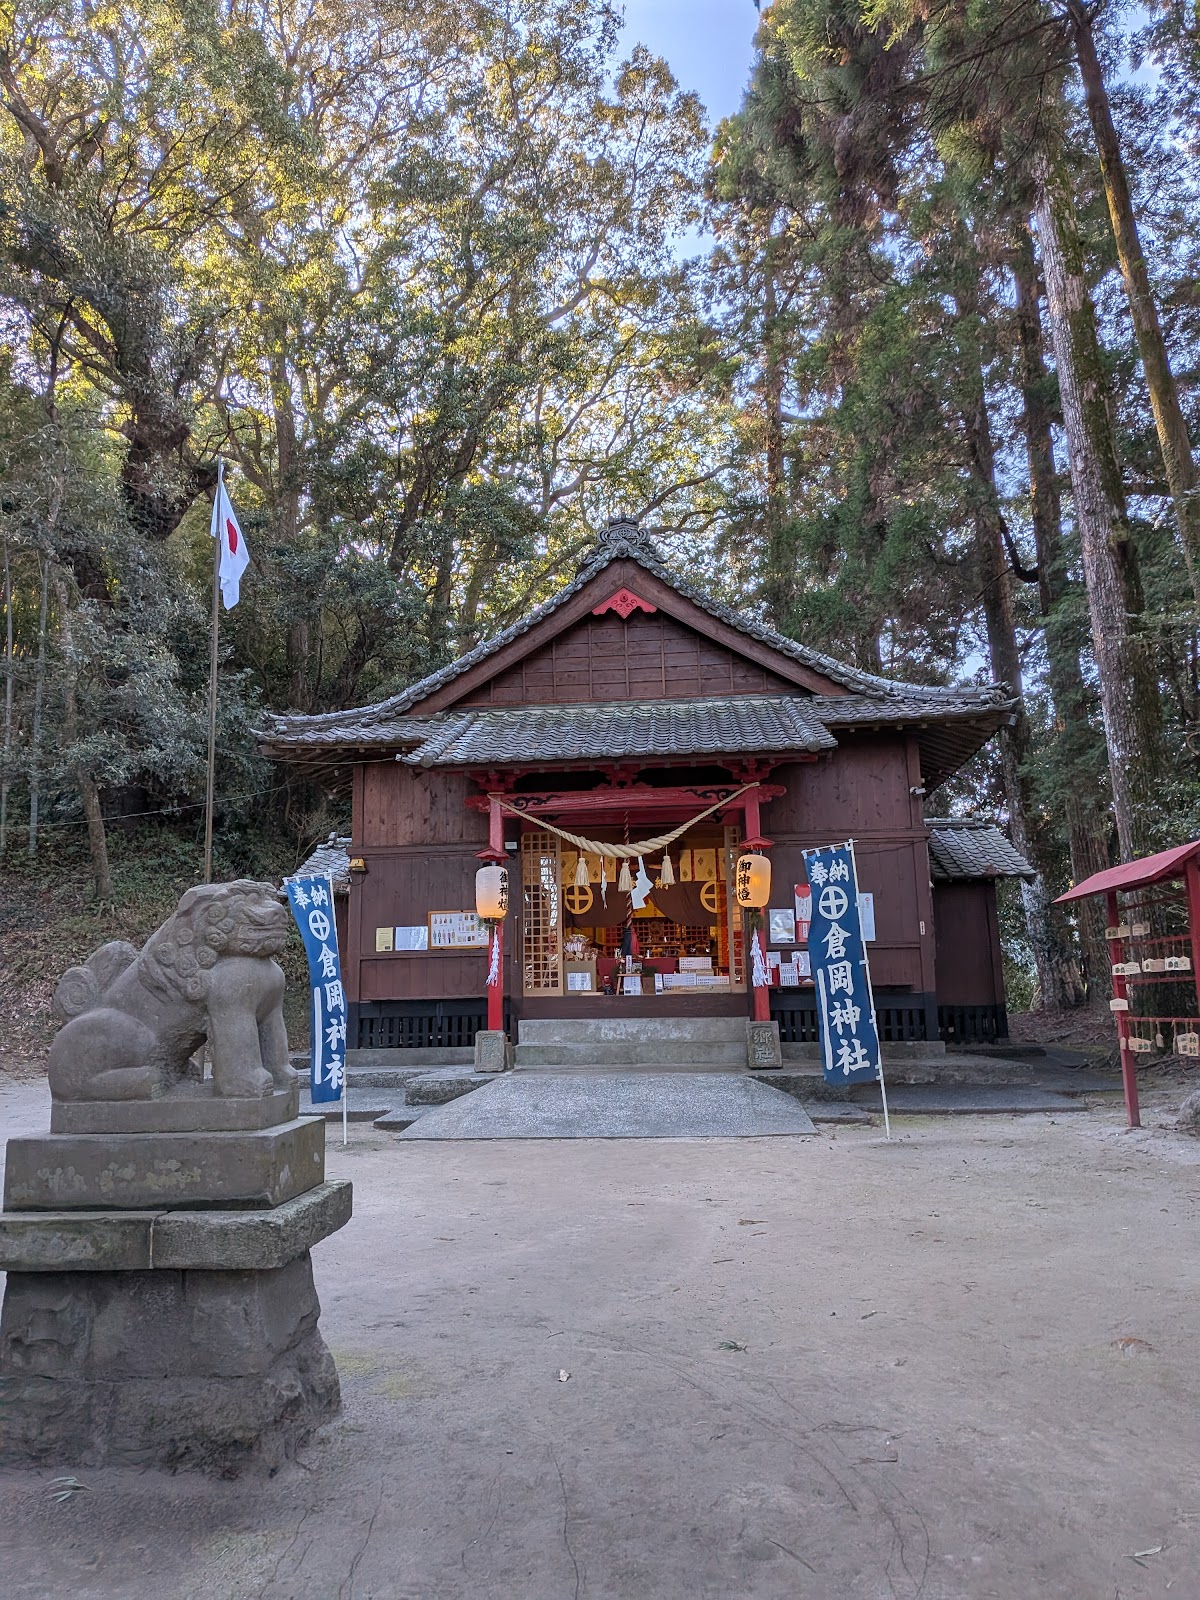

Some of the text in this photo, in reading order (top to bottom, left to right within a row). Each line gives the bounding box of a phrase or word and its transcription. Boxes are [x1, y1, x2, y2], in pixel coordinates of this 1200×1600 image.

[810, 858, 850, 888] 奉納
[294, 885, 329, 910] 奉納
[821, 922, 870, 1076] 倉岡神社
